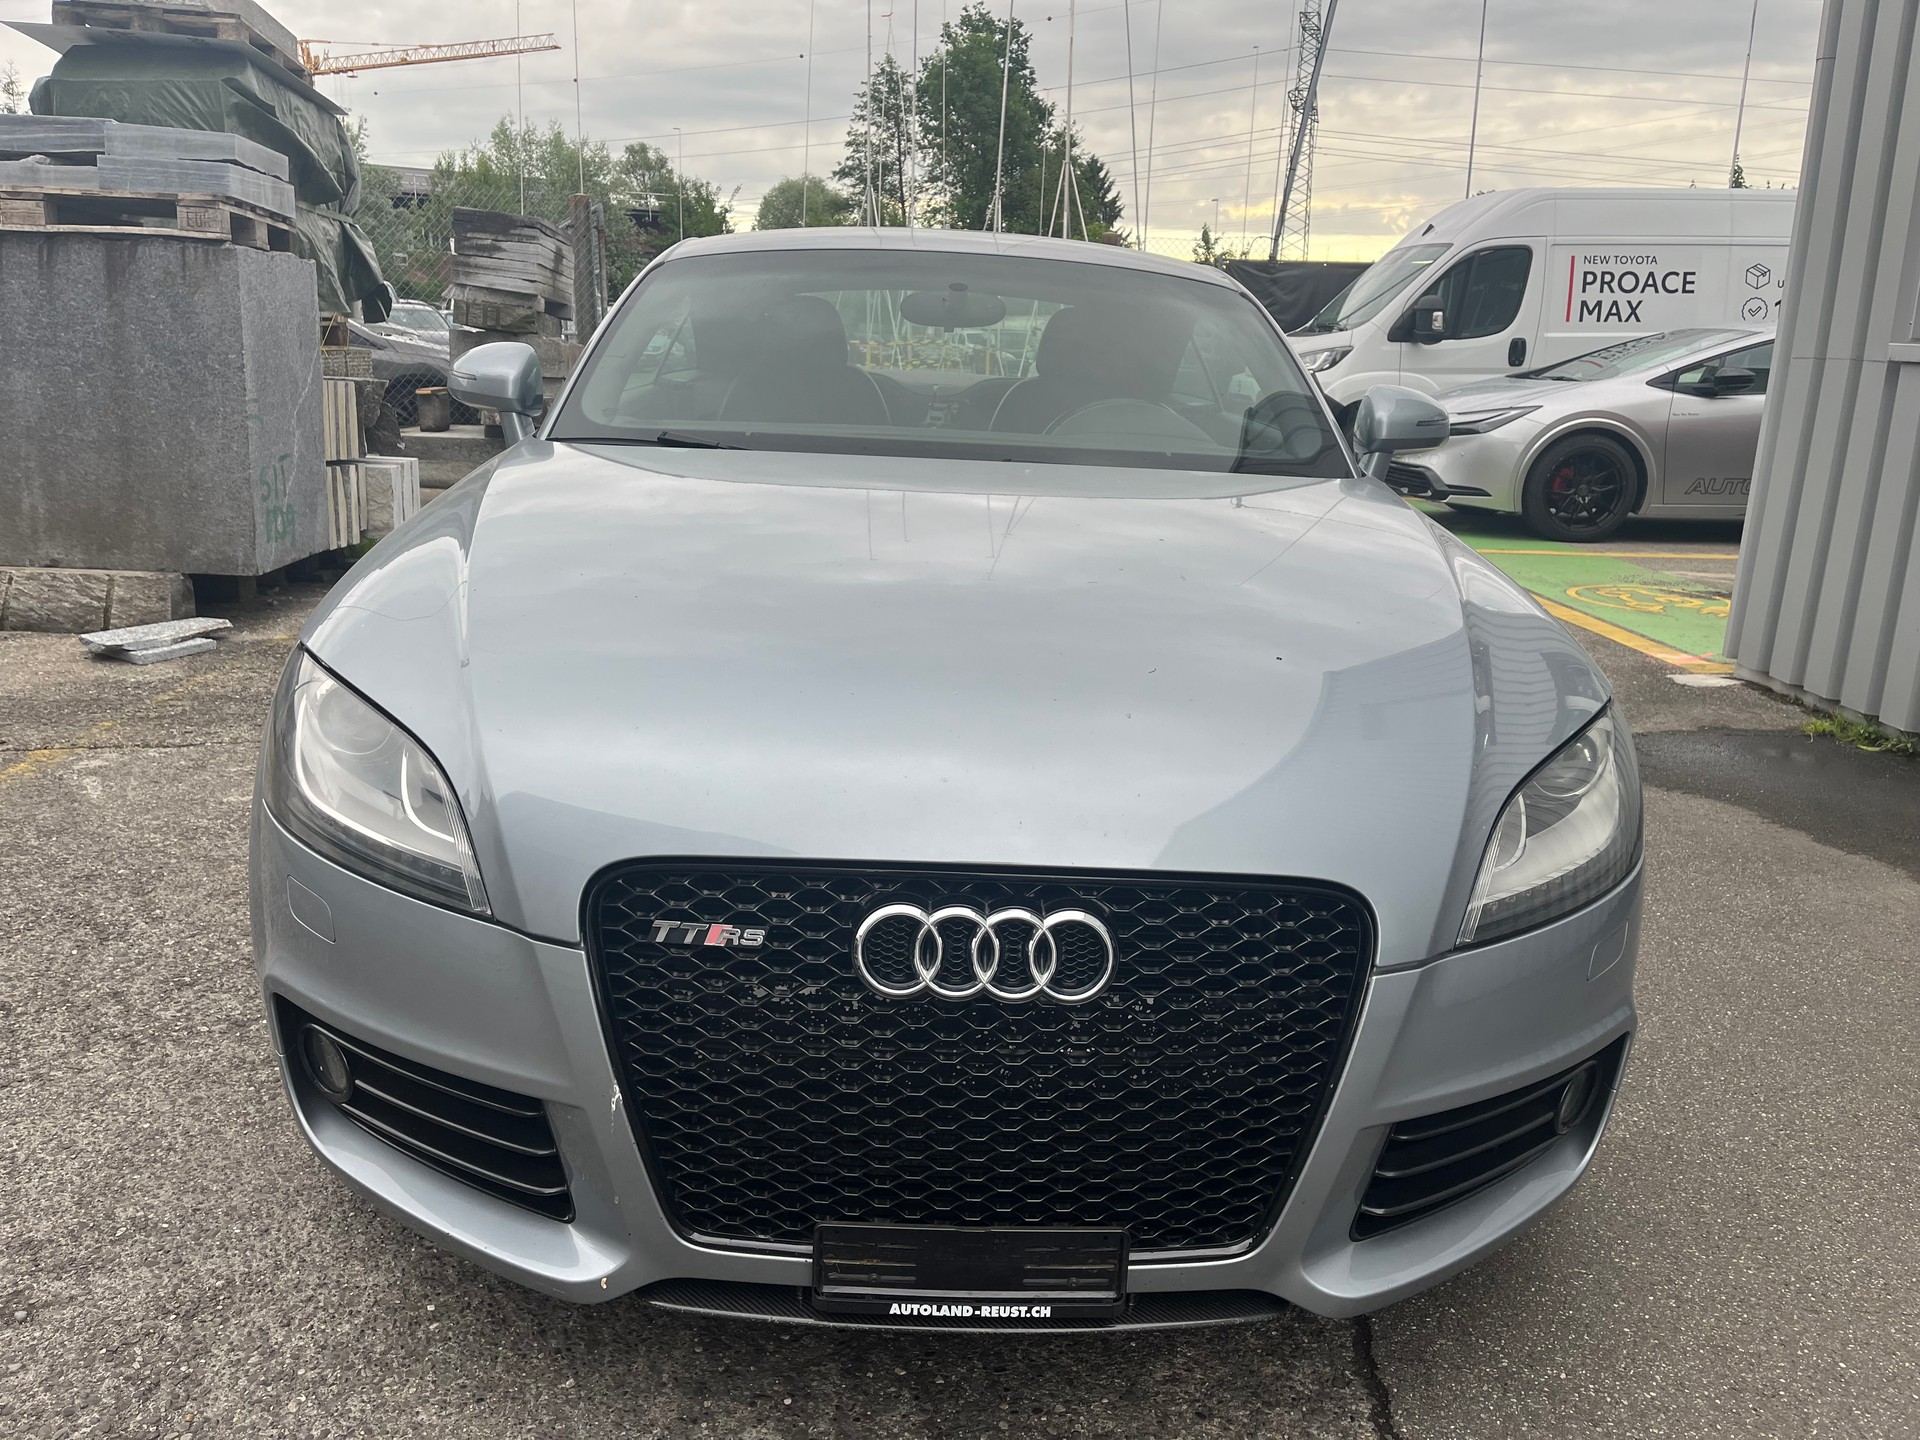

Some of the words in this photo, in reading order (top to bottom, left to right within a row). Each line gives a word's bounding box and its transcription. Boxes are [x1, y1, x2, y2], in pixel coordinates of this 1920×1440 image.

[1583, 255, 1611, 265] NEW
[1613, 255, 1658, 265] TOYOTA
[1581, 271, 1697, 294] PROACE
[1578, 300, 1644, 323] MAX
[889, 1303, 1051, 1318] AUTOLAND-REUST.CH
